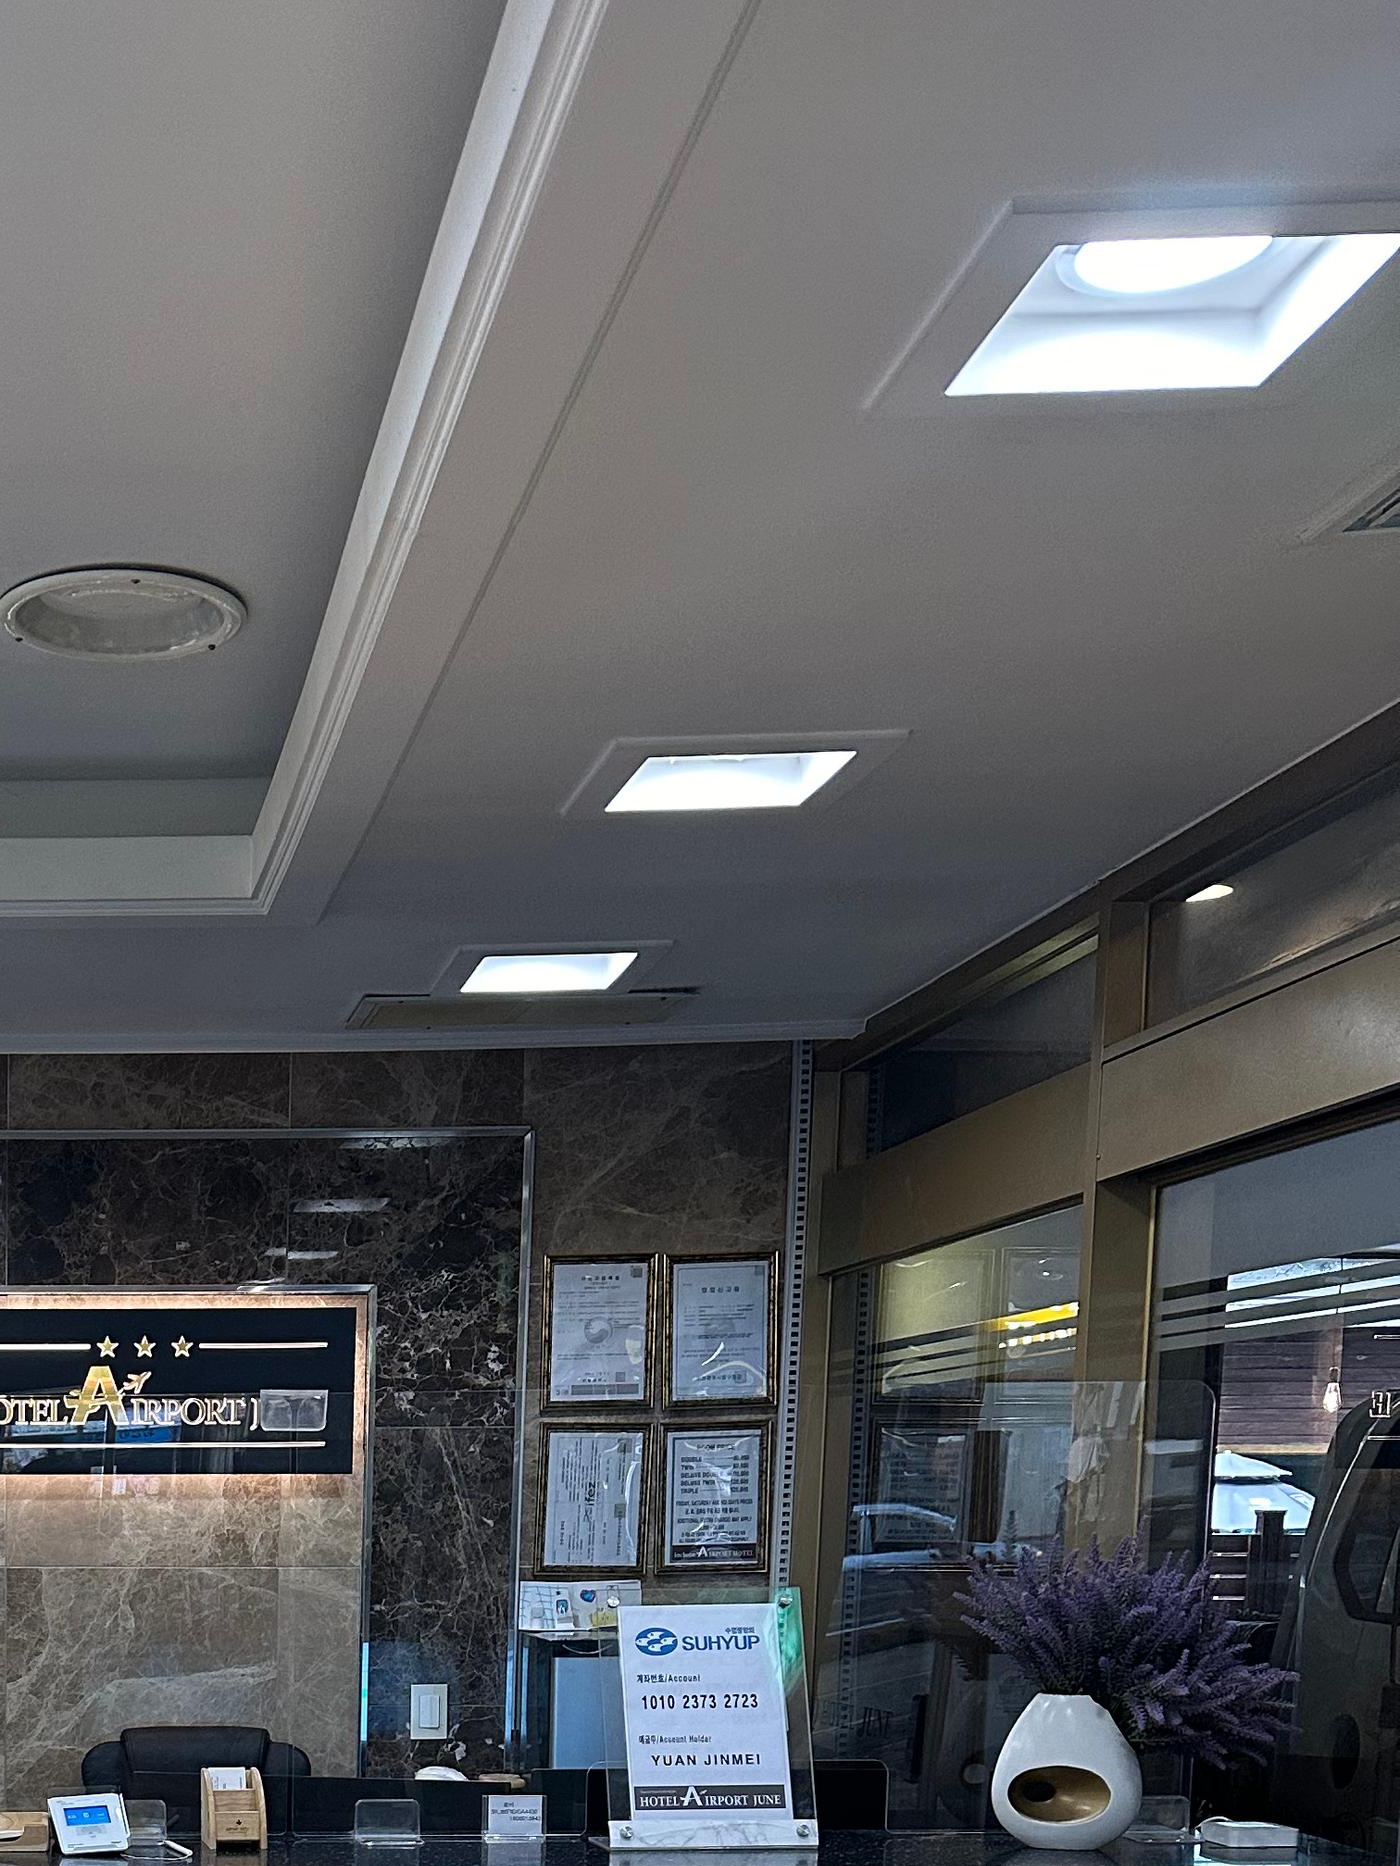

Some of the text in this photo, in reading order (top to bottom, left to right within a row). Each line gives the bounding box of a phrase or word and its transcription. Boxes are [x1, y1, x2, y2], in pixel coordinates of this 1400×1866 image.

[65, 1365, 246, 1426] AIRPORT
[682, 1635, 761, 1651] SUHYUP
[641, 1694, 759, 1709] 1010 2373 2723
[651, 1754, 761, 1766] YUAN JINMEI
[640, 1796, 680, 1807] HOTEL
[682, 1786, 749, 1806] AIRPORT
[752, 1795, 782, 1806] JUNE
